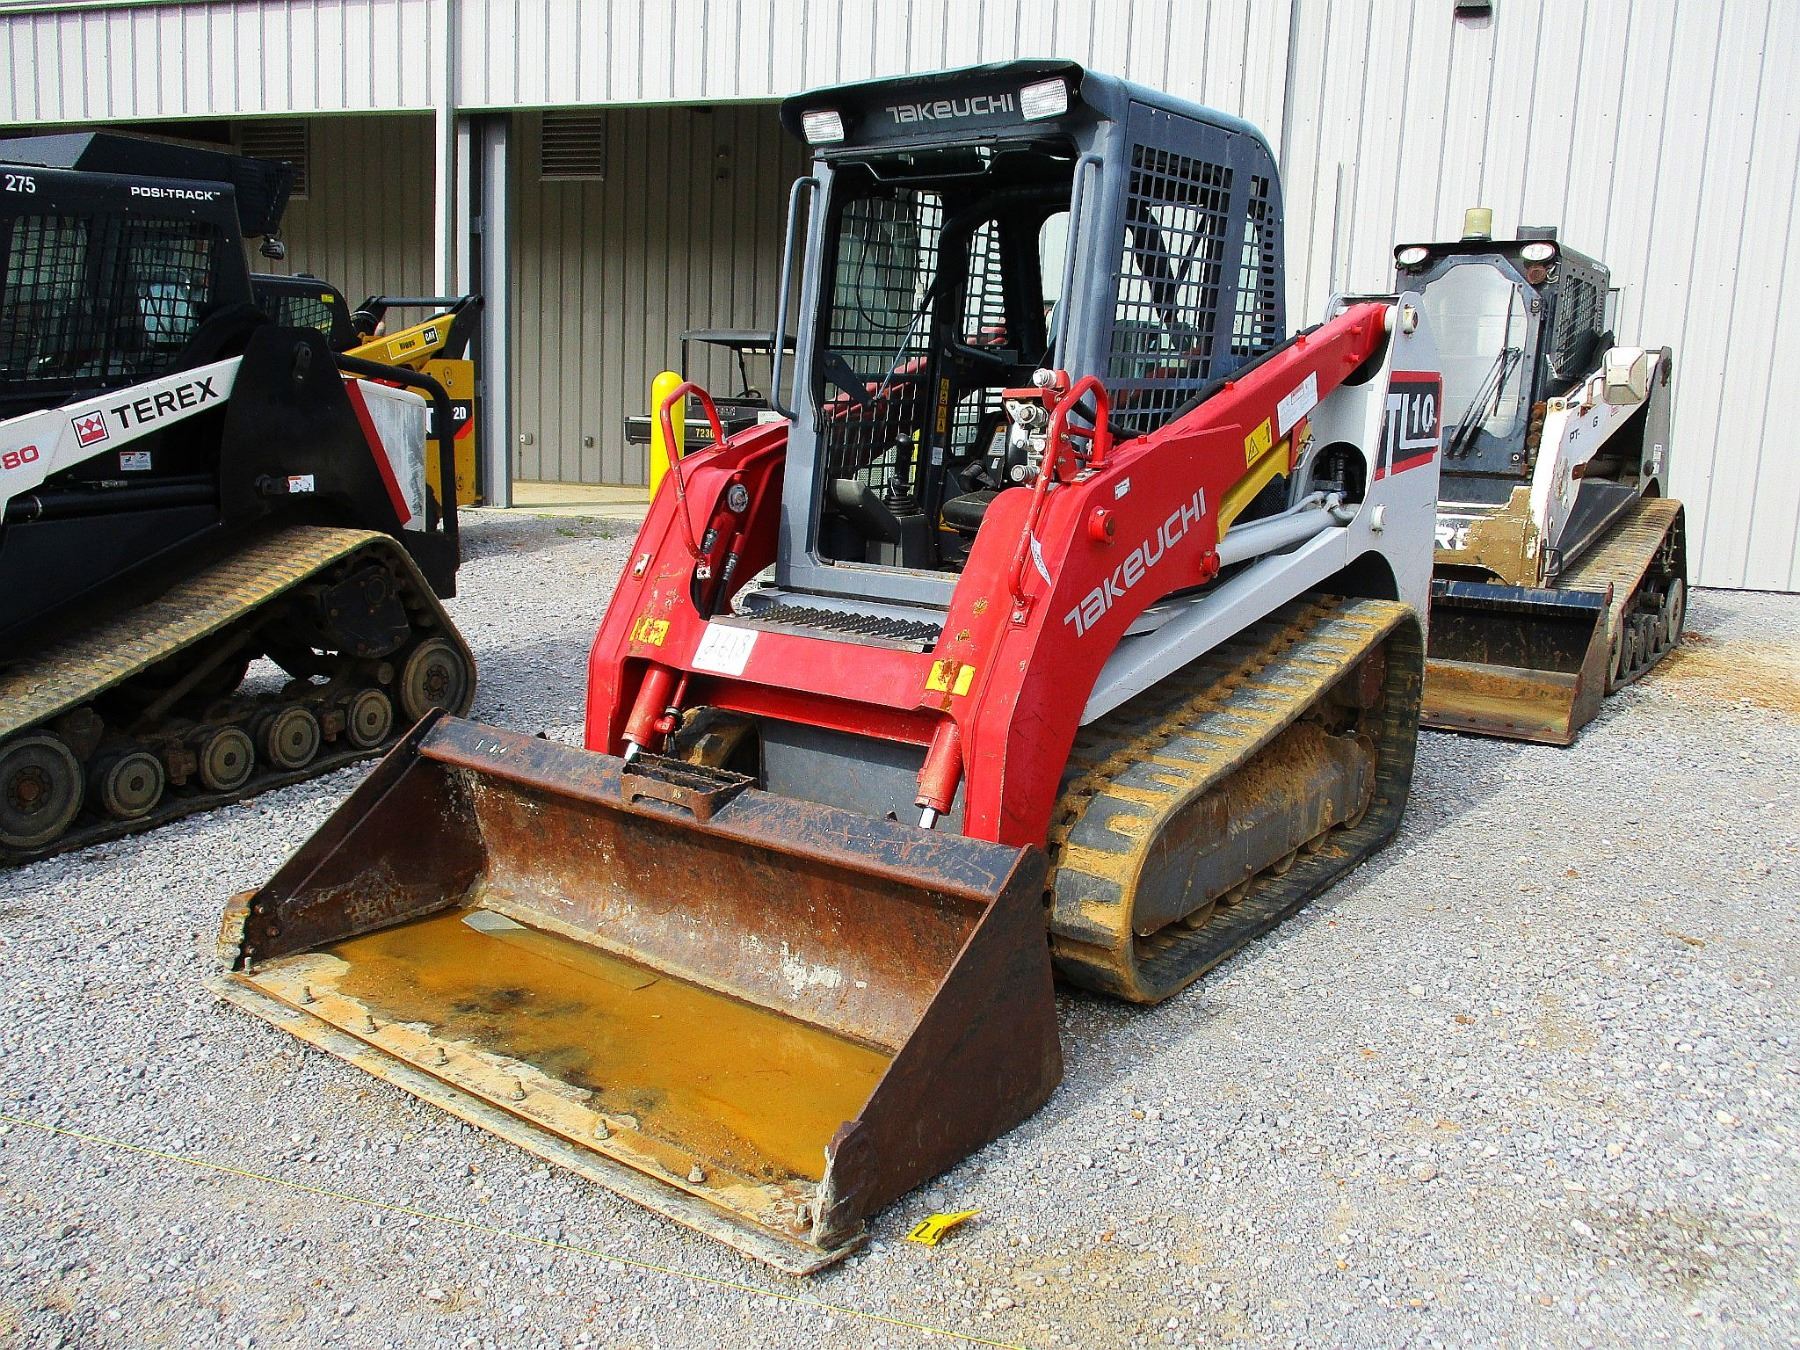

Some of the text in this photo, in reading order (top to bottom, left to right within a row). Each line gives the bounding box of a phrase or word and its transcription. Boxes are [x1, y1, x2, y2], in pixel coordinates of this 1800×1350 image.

[886, 93, 1014, 124] TAKEUCHI
[5, 174, 36, 194] 275
[111, 377, 219, 429] TEREX
[1063, 487, 1207, 638] TAKEUCHI
